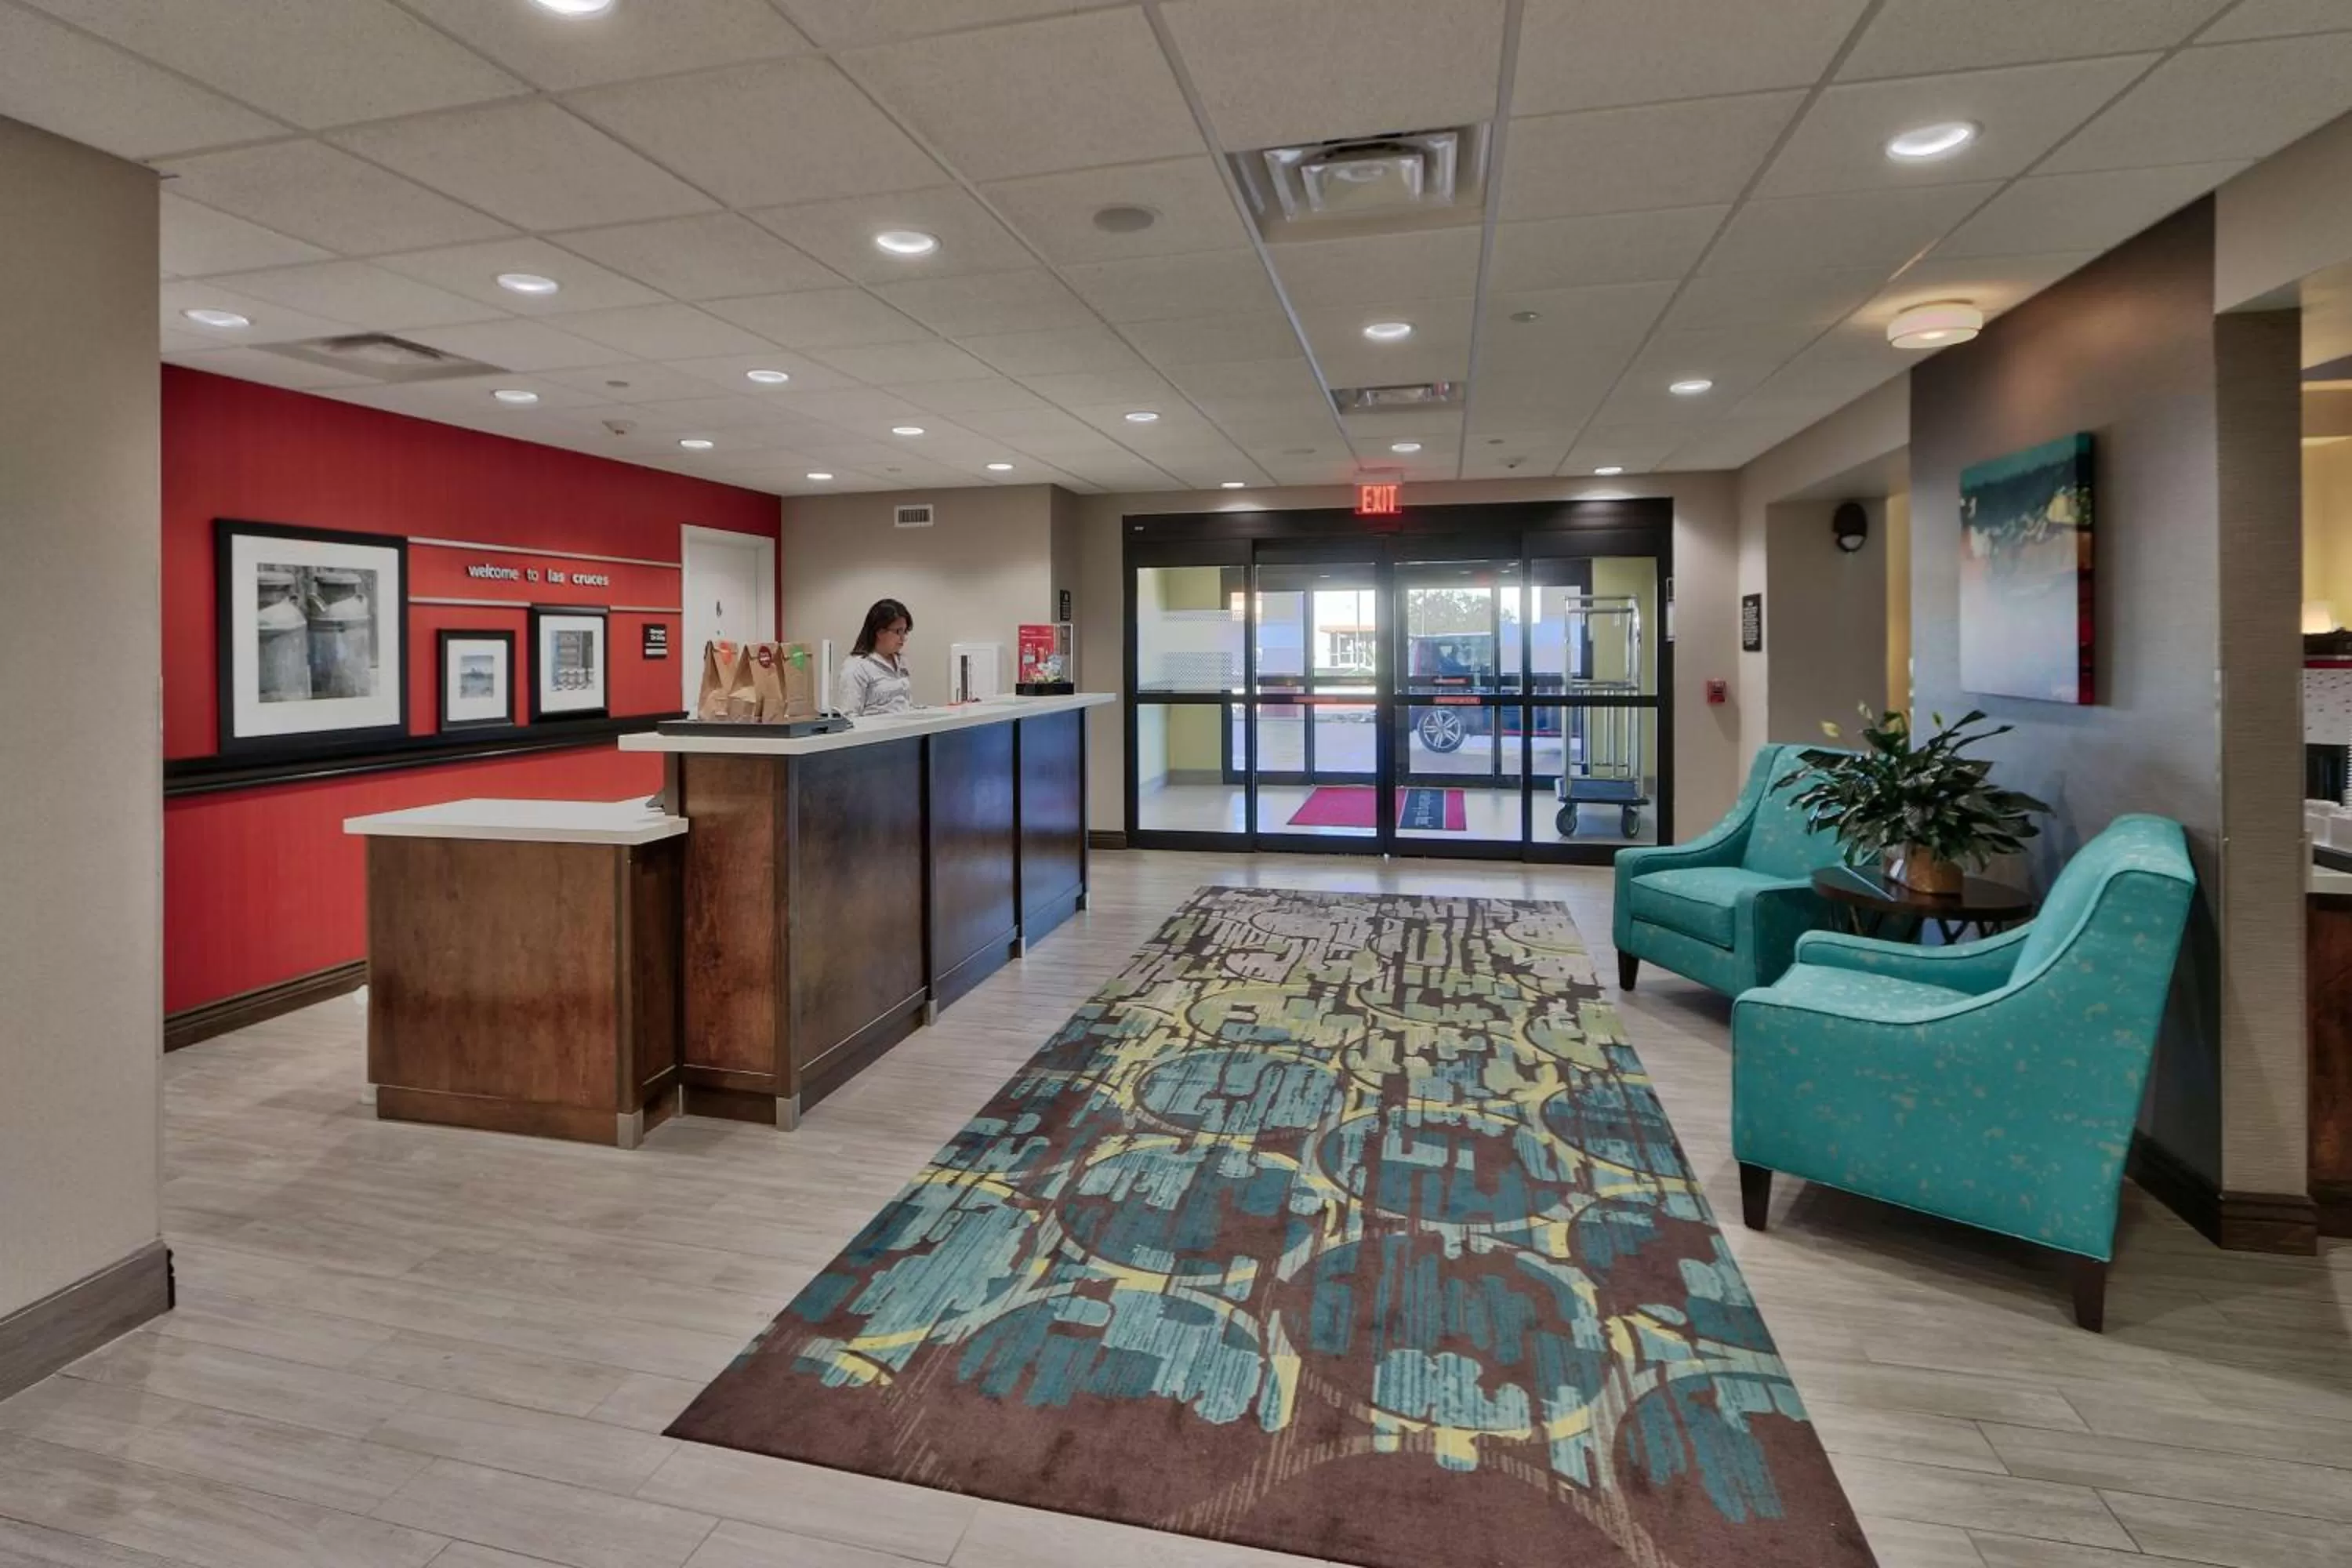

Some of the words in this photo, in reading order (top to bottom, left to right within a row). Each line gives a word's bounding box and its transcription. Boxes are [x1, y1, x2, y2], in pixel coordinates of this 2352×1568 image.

[1362, 485, 1397, 513] EXIT
[468, 564, 519, 580] welcome
[526, 568, 539, 583] to
[547, 568, 565, 583] las
[572, 572, 609, 586] cruces
